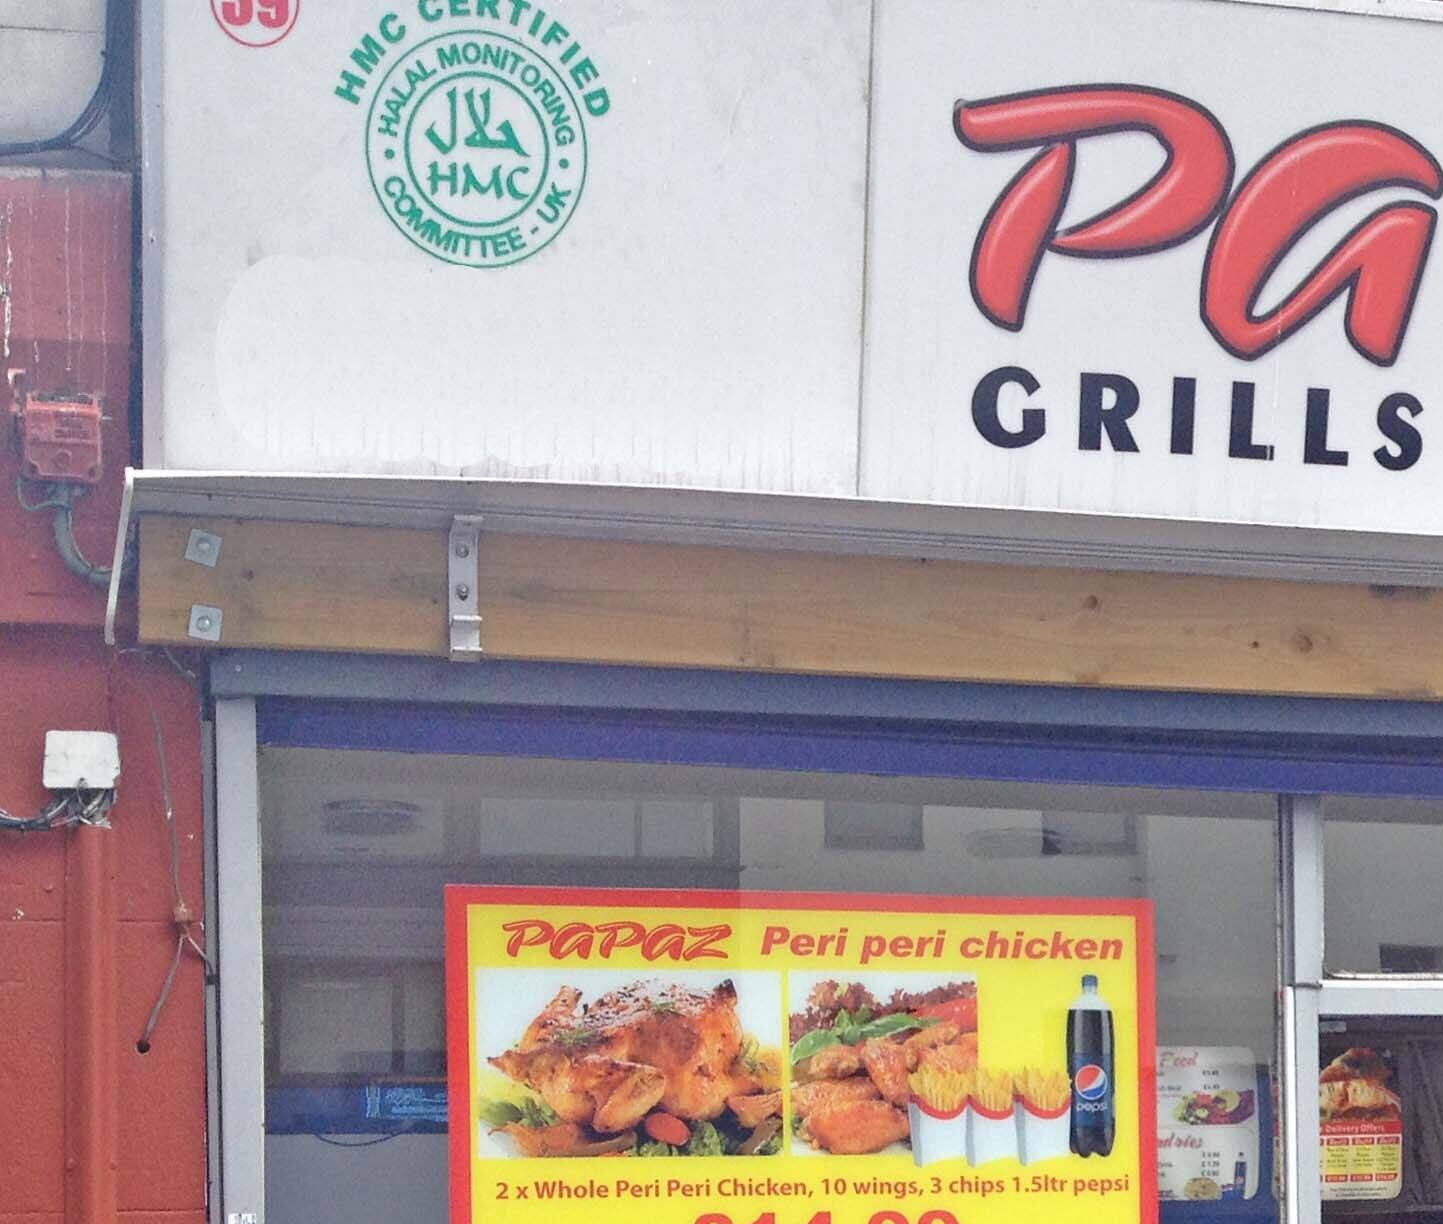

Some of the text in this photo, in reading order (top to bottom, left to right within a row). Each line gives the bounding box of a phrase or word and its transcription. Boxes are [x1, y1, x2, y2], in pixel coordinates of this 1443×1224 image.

[334, 0, 611, 118] HMC CERTIFIED
[378, 42, 576, 146] HALAL MONITORING
[384, 175, 526, 258] COMMITTEE
[537, 182, 572, 224] UK
[427, 161, 530, 200] HMC
[972, 366, 1424, 474] GRILLS
[761, 926, 848, 958] Peri
[860, 929, 948, 966] peri
[959, 929, 1125, 961] chicken
[496, 1175, 1129, 1200] 2 x Whole Peri Peri Chicken, 10 wings, 3 chips 1.5ltr pepsi
